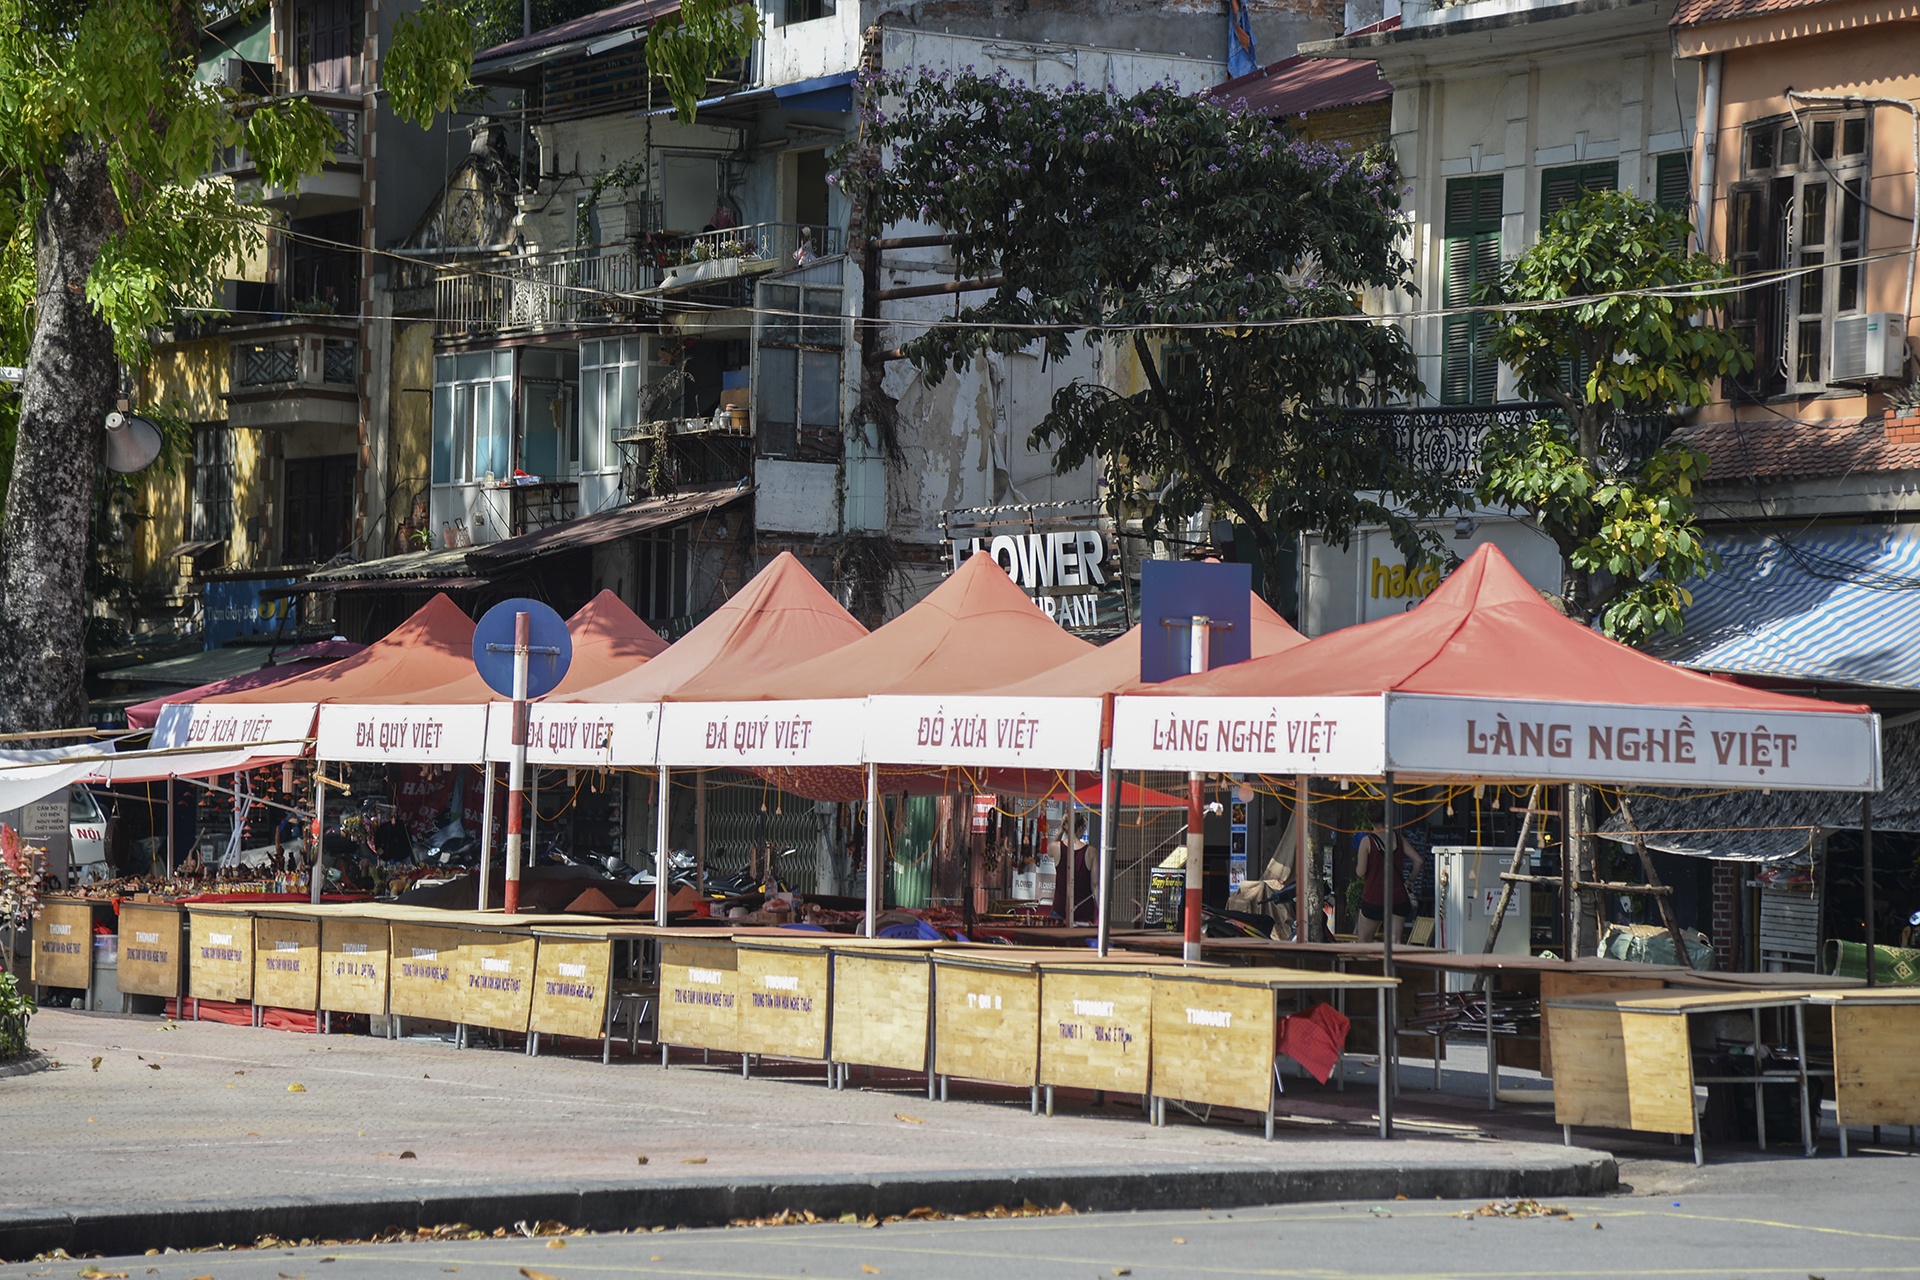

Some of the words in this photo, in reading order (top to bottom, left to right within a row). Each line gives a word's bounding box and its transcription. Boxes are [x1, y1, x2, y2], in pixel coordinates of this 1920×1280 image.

[953, 530, 1105, 588] FOWER
[187, 710, 210, 742] ĐỒ
[211, 716, 237, 742] XƯA
[241, 714, 273, 743] VIỆT
[356, 716, 375, 747] ĐÁ
[380, 717, 408, 753] QUÝ
[412, 717, 443, 754] VIỆT
[527, 716, 544, 749] ĐÁ
[549, 716, 578, 755] QUÝ
[582, 716, 614, 755] VIỆT
[705, 716, 728, 749] ĐÁ
[733, 715, 769, 756] QUÝ
[774, 714, 812, 757] VIỆT
[917, 704, 944, 747] ĐỒ
[950, 713, 988, 749] XƯA
[996, 711, 1040, 757] VIỆT
[1152, 711, 1209, 751] LÀNG
[1216, 706, 1277, 754] NGHỀ
[1286, 712, 1337, 762] VIỆT
[1466, 712, 1573, 759] LÀNG
[1588, 715, 1696, 765] NGHỀ
[1711, 724, 1798, 776] VIỆT
[76, 828, 102, 843] NỘI
